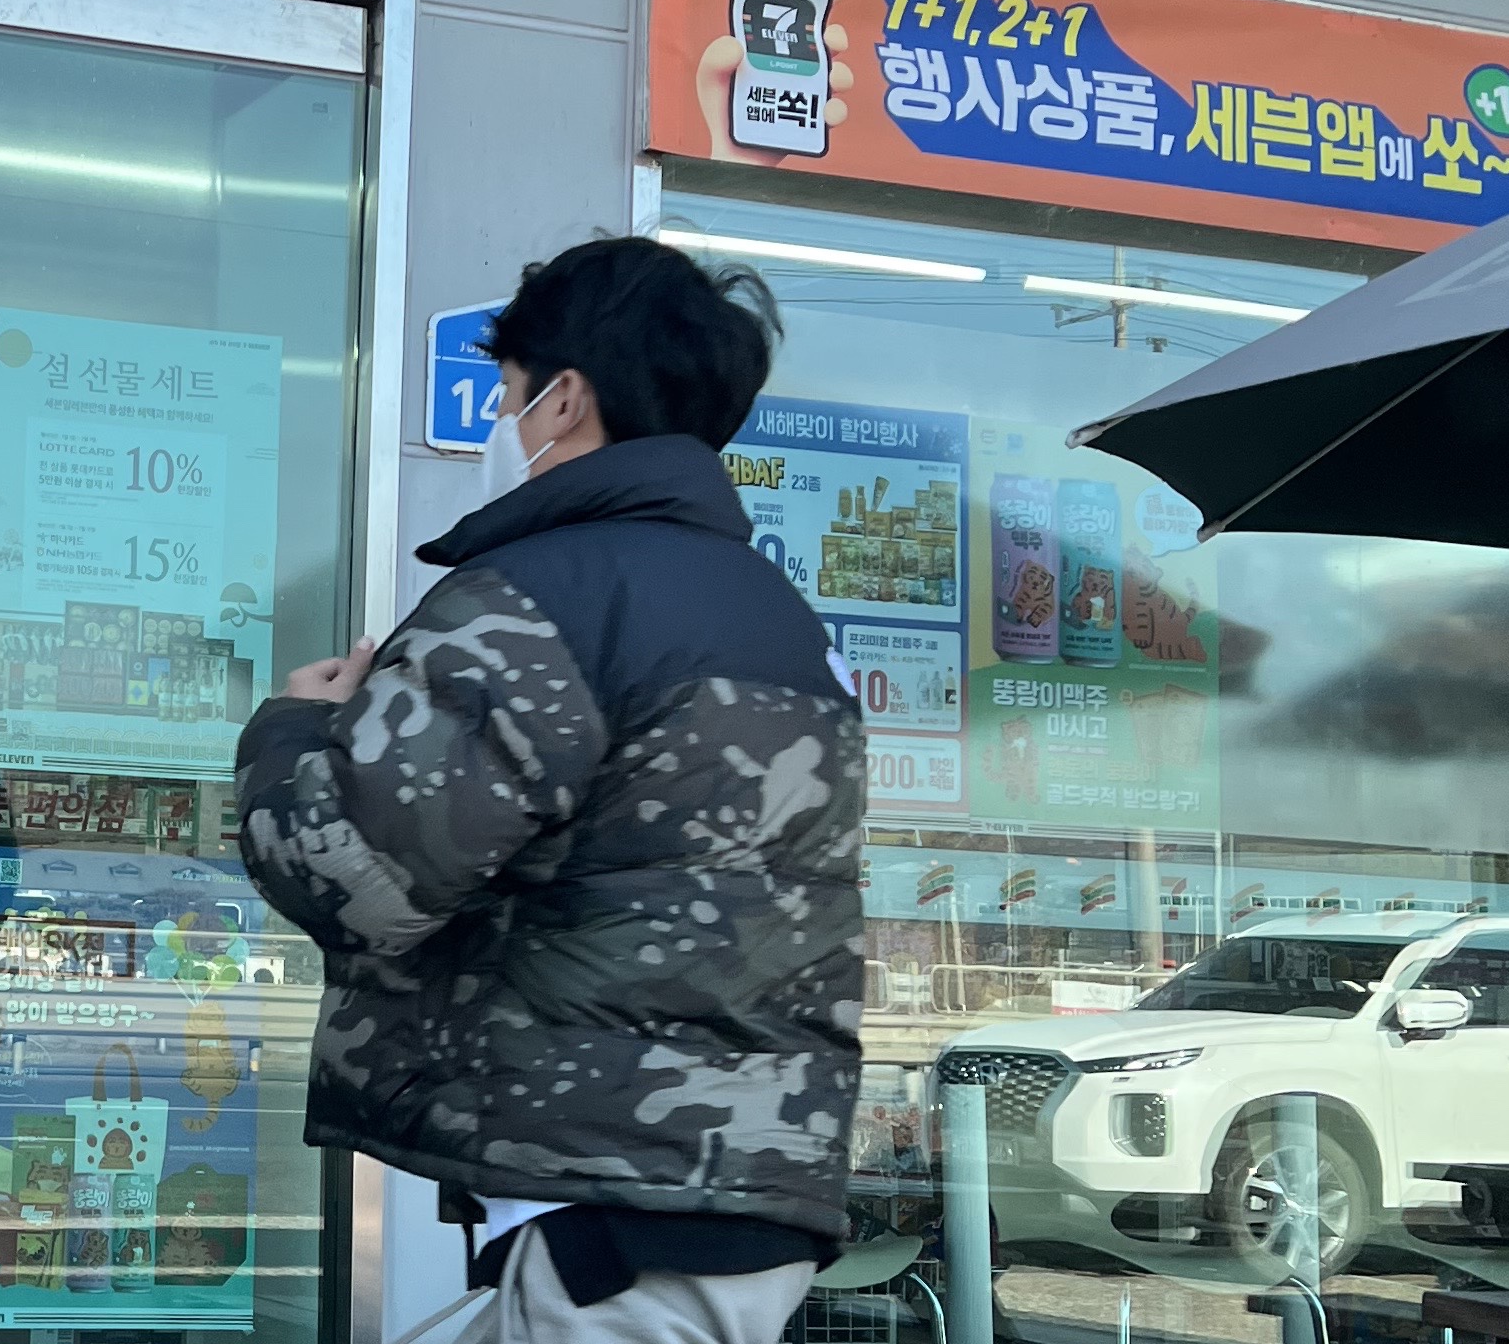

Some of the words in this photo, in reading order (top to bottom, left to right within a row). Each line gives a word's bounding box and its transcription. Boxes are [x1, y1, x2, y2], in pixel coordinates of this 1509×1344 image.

[747, 86, 776, 104] 세븐
[777, 90, 819, 128] 쏙!
[747, 106, 775, 123] 앱에
[878, 43, 1174, 156] 행사상품,
[1186, 82, 1414, 183] 세븐앱에
[39, 353, 70, 390] 설
[79, 357, 145, 398] 선물
[151, 364, 218, 403] 세트
[756, 409, 833, 441] 새해맞이
[841, 416, 918, 448] 할인행사
[126, 446, 203, 494] 10%
[791, 474, 821, 492] 23종
[997, 499, 1053, 531] 뚱랑이
[125, 535, 198, 582] 15%
[849, 633, 889, 646] 프리미엄
[892, 637, 922, 650] 전통주
[993, 678, 1108, 713] 뚱랑이맥주
[1047, 713, 1108, 739] 마시고
[1046, 783, 1118, 808] 골드부적
[1123, 787, 1200, 813] 받으랑구!
[6, 1000, 48, 1025] 많이
